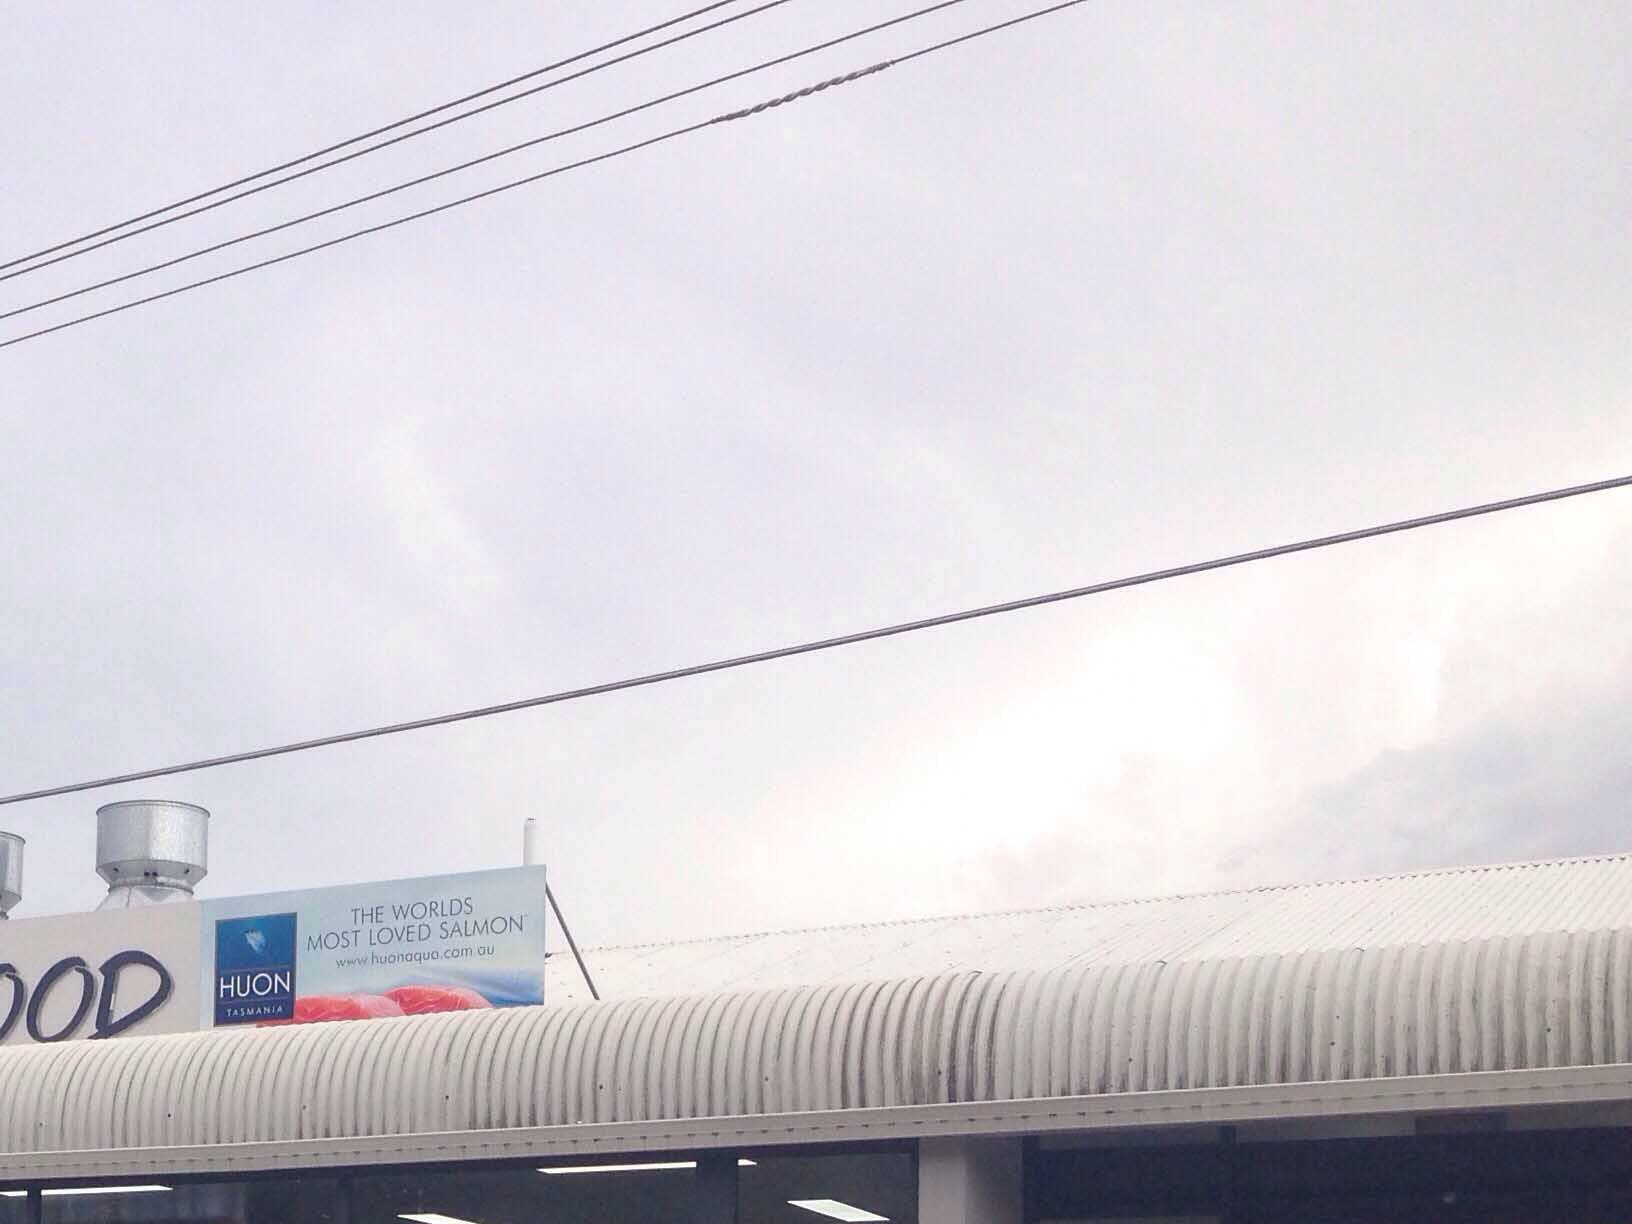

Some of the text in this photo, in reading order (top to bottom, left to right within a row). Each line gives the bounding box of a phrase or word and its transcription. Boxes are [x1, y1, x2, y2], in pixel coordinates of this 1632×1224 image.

[351, 896, 474, 926] THE WORLDS
[307, 914, 524, 953] MOST LOVED SALMON
[219, 971, 291, 999] HUON
[226, 1005, 284, 1018] TASMANIA
